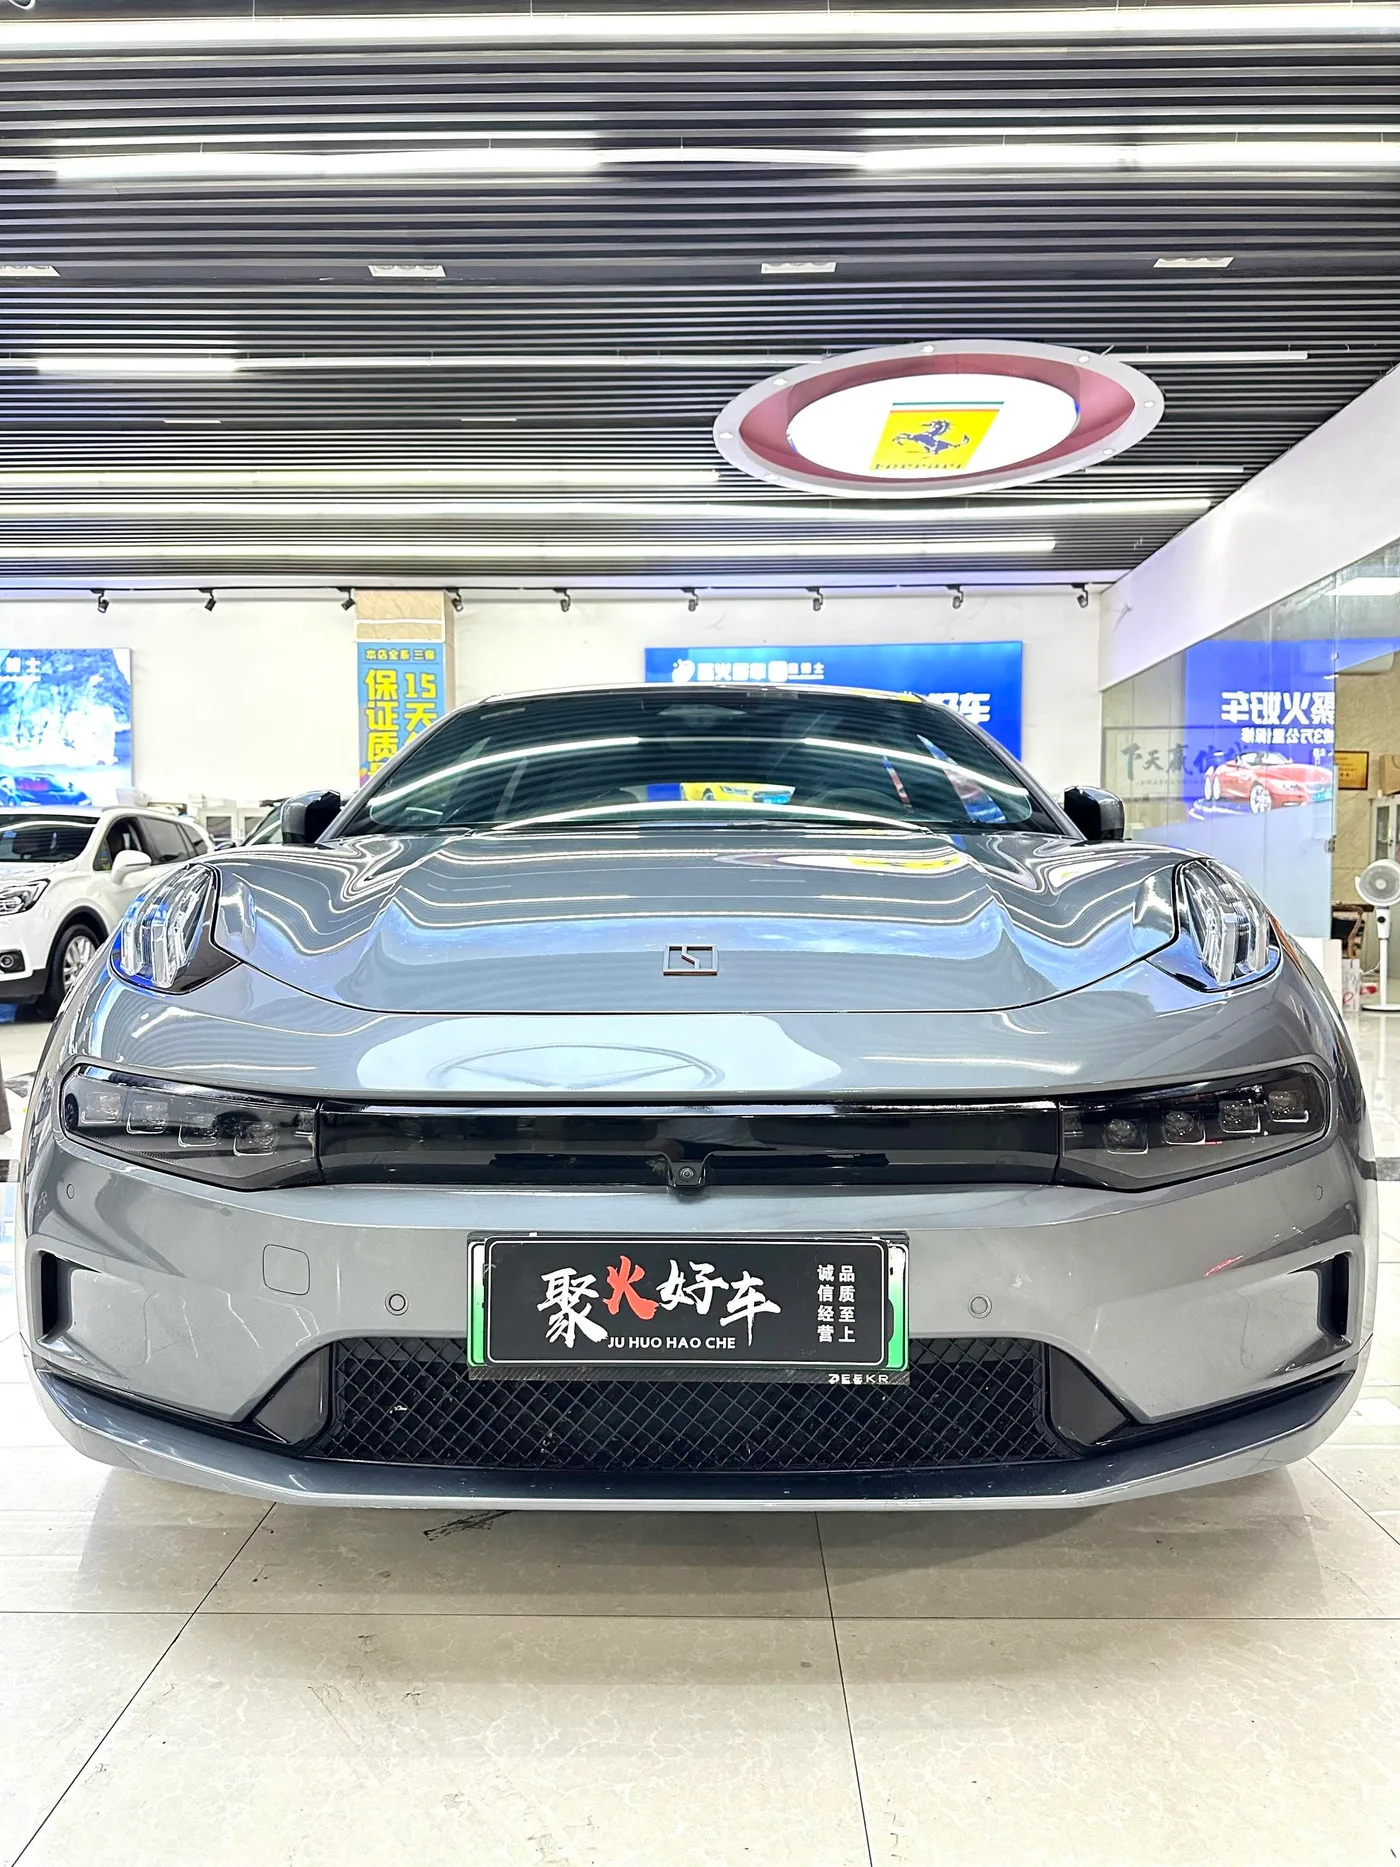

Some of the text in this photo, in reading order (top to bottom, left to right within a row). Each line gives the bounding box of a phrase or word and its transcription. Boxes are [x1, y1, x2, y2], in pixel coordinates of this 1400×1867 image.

[405, 673, 437, 745] 15天
[537, 1255, 782, 1348] 聚火好车
[817, 1264, 834, 1343] 诚信经营
[838, 1265, 856, 1343] 品质至上
[608, 1337, 736, 1349] JU HUO HAO CHE
